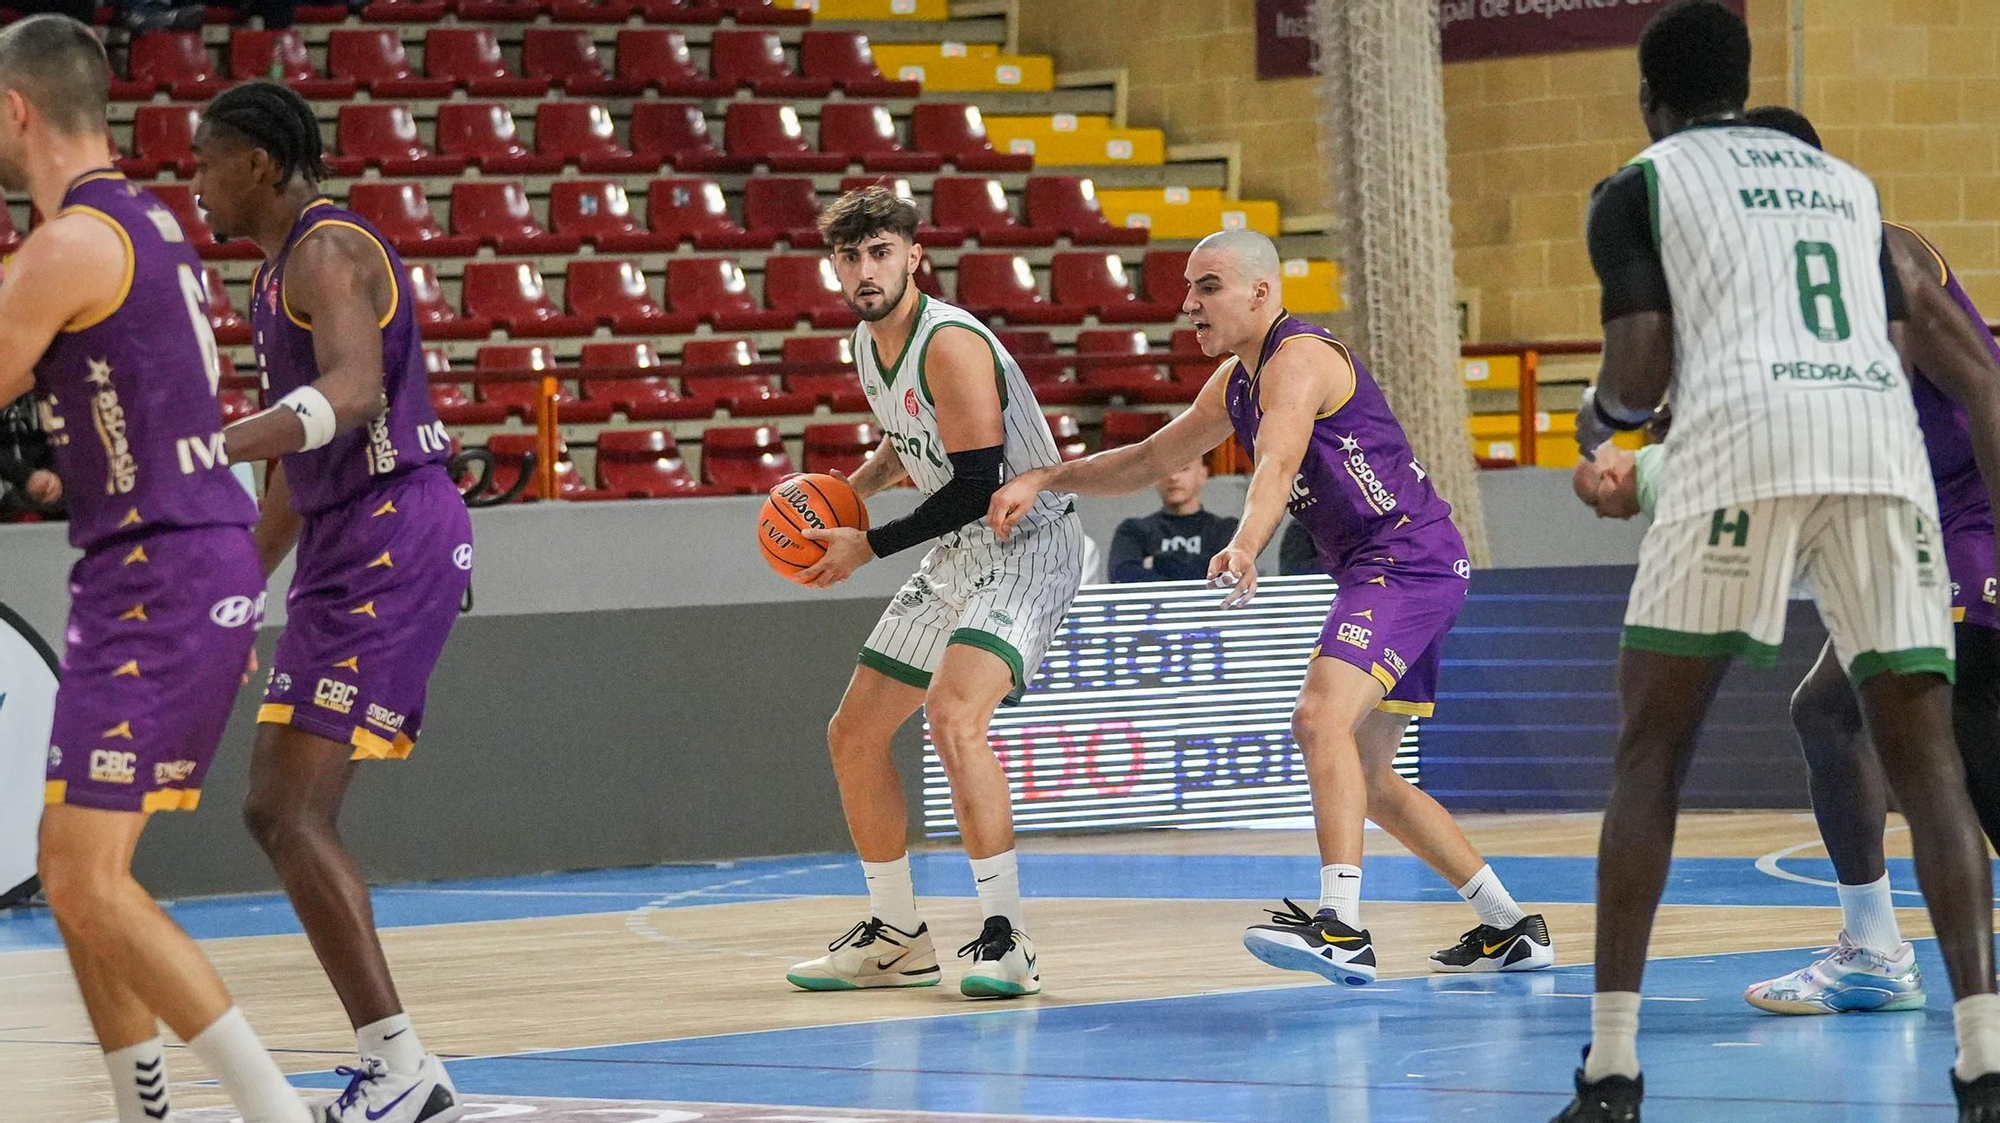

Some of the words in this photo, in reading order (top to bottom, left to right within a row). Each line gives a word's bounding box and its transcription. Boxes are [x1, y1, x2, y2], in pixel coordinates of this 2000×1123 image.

[1728, 149, 1835, 175] LAMINE
[1785, 190, 1857, 223] RAHI
[1795, 240, 1851, 344] 8
[1772, 361, 1862, 382] PIEDRA
[1350, 452, 1397, 512] aspasia
[1337, 622, 1373, 645] CBC
[315, 677, 359, 707] CBC
[90, 749, 137, 776] CBC
